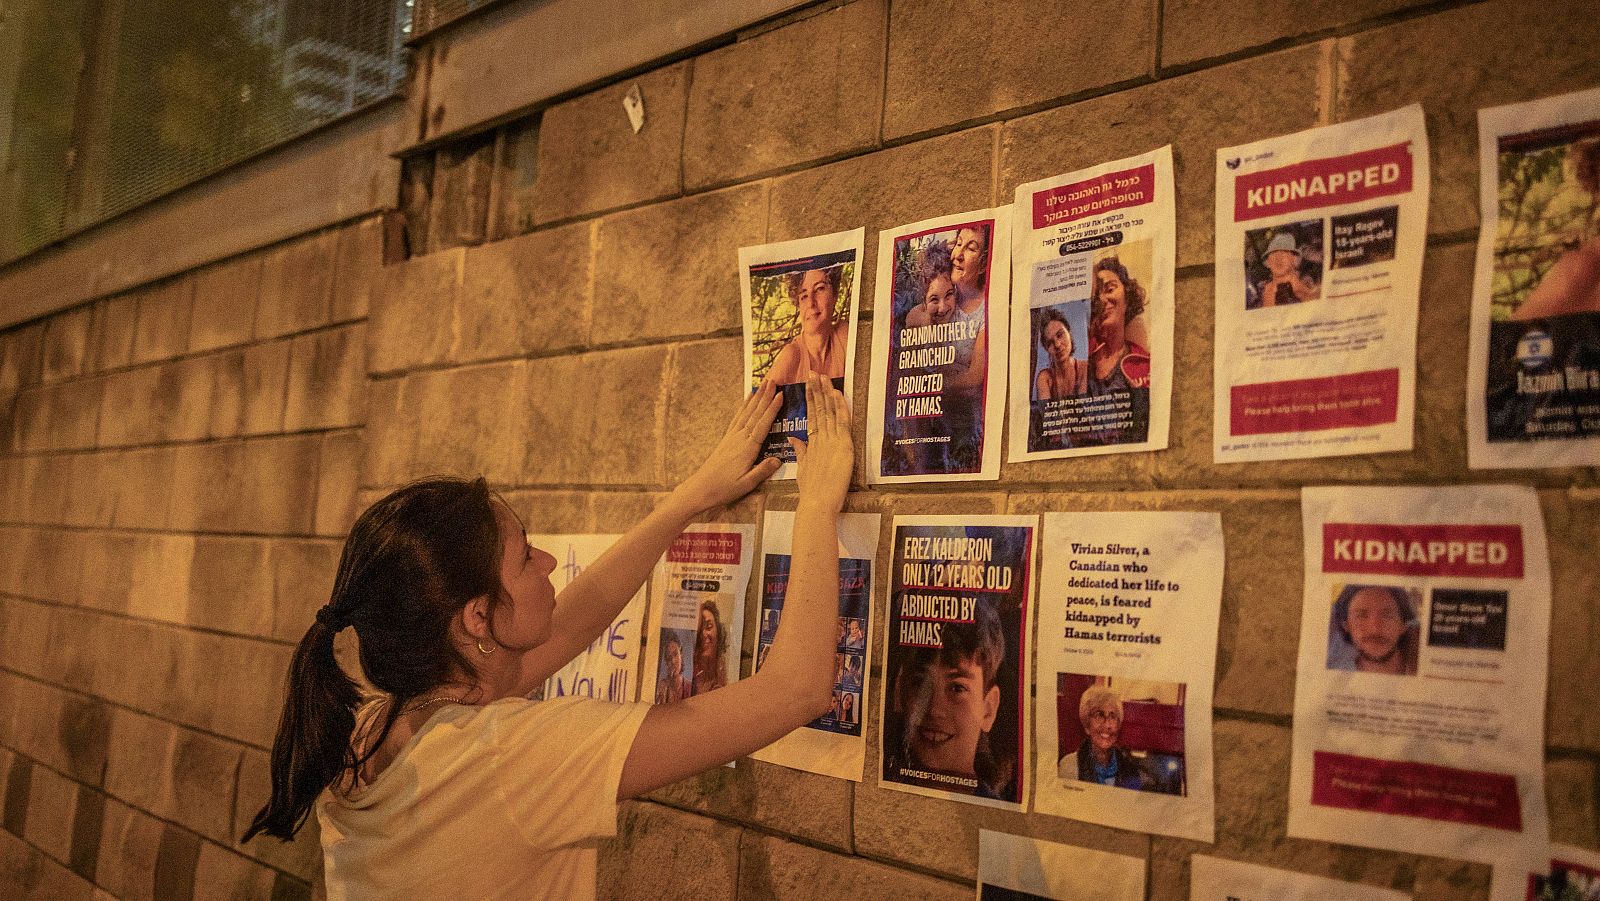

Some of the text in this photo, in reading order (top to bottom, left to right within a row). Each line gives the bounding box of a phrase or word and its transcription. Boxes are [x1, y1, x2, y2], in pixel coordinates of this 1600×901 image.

[1046, 176, 1140, 207] כרמל גת האהובה שלנו
[1247, 162, 1400, 209] KIDNAPPED
[1043, 210, 1069, 222] בבוקר
[1071, 203, 1090, 215] שבת
[900, 320, 976, 347] GRANDMOTHER &
[899, 346, 956, 369] GRANDCHILD
[897, 374, 943, 395] ABDUCTED
[896, 396, 943, 417] BY HAMAS.
[904, 537, 992, 561] EREZ KALDERON
[1071, 543, 1150, 557] Vivian Silver, a
[1333, 539, 1508, 565] KIDNAPPED
[903, 563, 1011, 590] ONLY 12 YEARS OLD
[1069, 560, 1148, 573] Canadian who
[1068, 577, 1180, 592] dedicated her life to
[901, 595, 977, 620] ABDUCTED BY
[1066, 595, 1151, 608] peace, is feared
[1065, 610, 1141, 628] kidnapped by
[900, 621, 942, 645] HAMAS.
[1064, 627, 1161, 645] Hamas terrorists
[900, 768, 978, 788] #VOICESFORHOSTAGES
